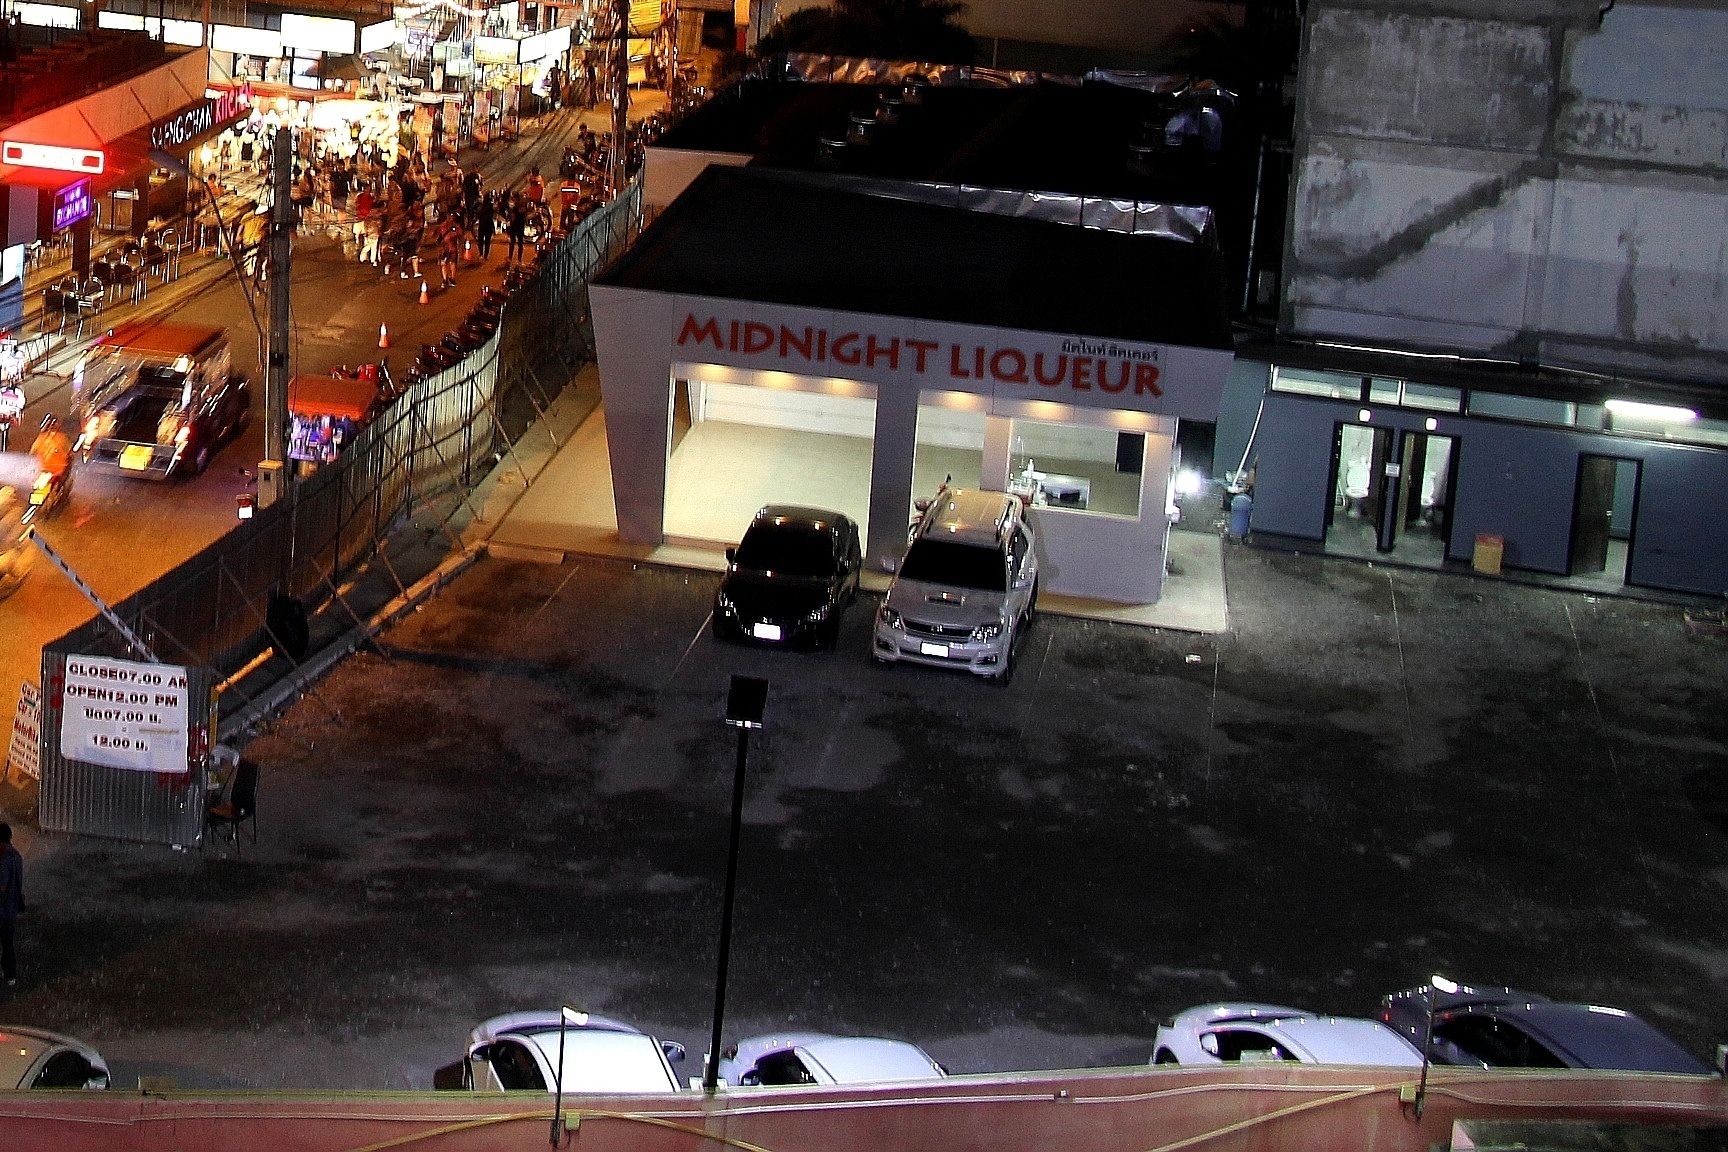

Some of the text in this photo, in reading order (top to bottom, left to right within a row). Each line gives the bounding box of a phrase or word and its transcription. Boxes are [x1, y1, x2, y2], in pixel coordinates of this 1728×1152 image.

[677, 312, 1164, 397] MIDNIGHT LIQUEUR
[154, 694, 178, 708] PM
